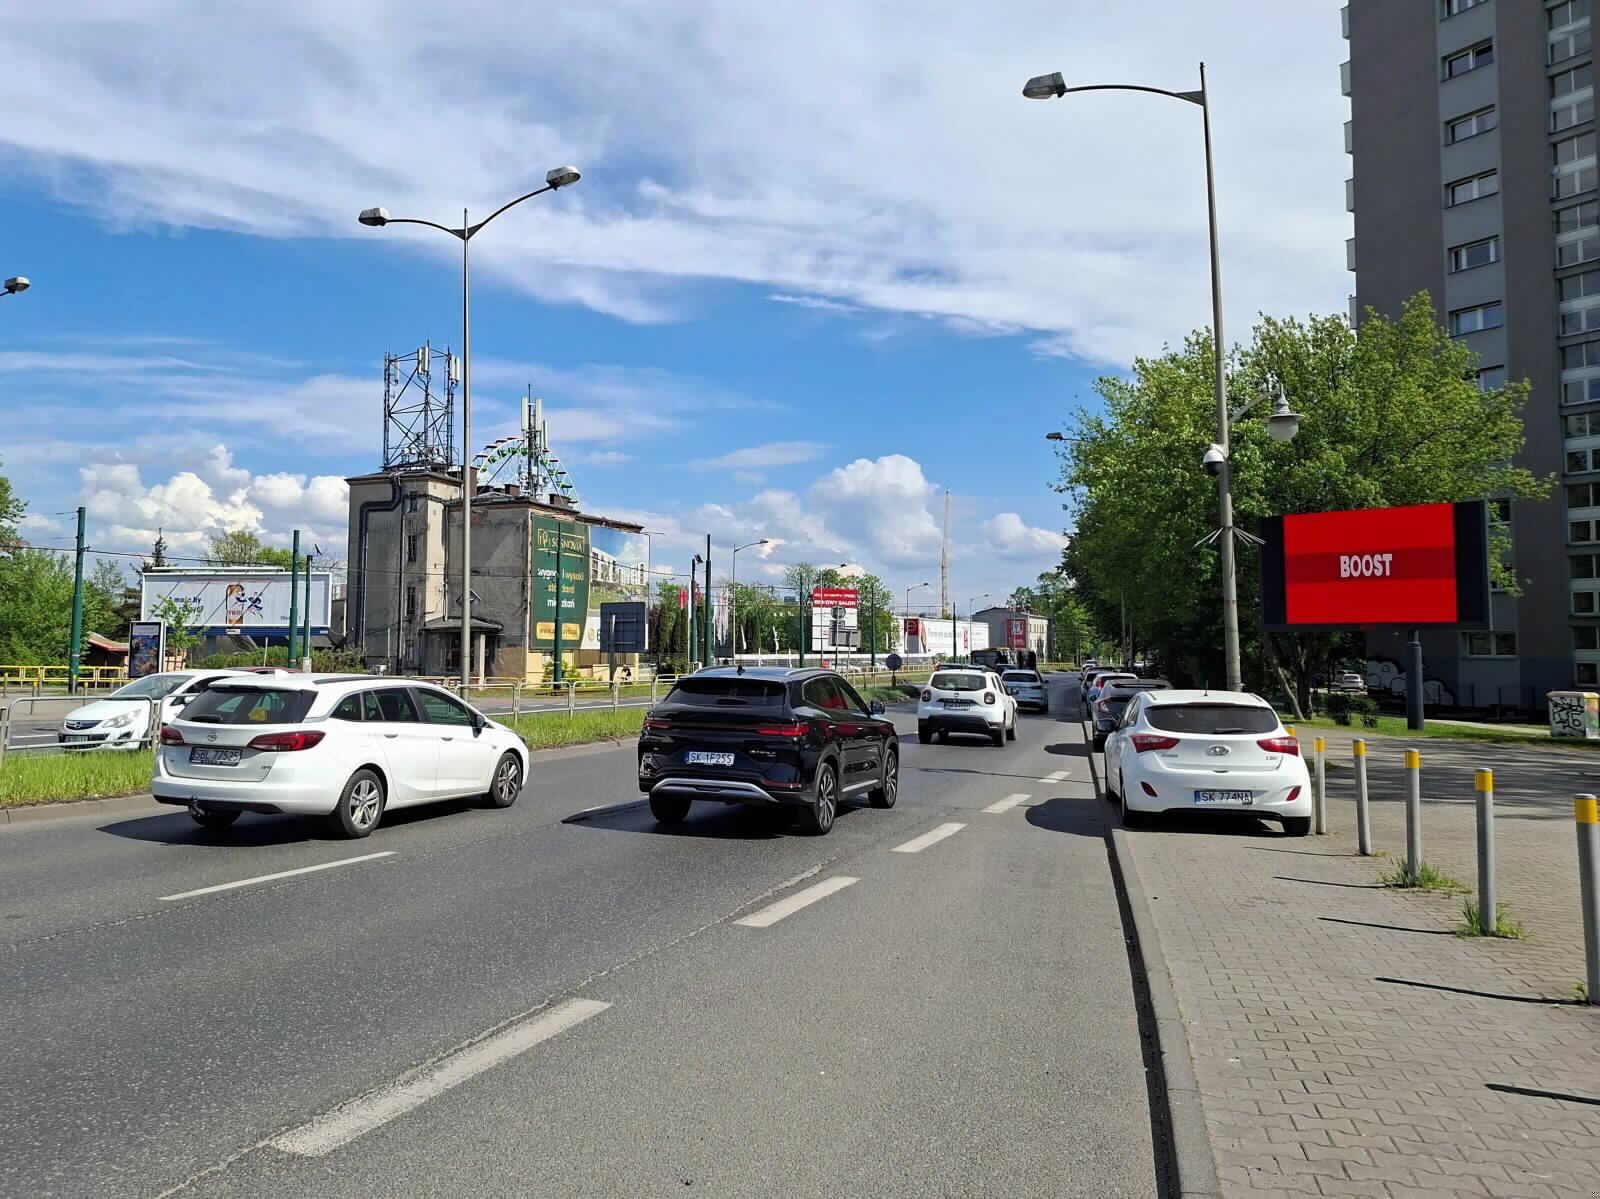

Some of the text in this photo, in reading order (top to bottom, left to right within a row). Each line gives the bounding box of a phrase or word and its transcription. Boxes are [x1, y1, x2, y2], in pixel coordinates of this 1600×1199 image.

[1340, 553, 1393, 578] BOOST
[547, 597, 575, 608] miezkań
[690, 752, 701, 762] SK
[1201, 791, 1215, 801] SK
